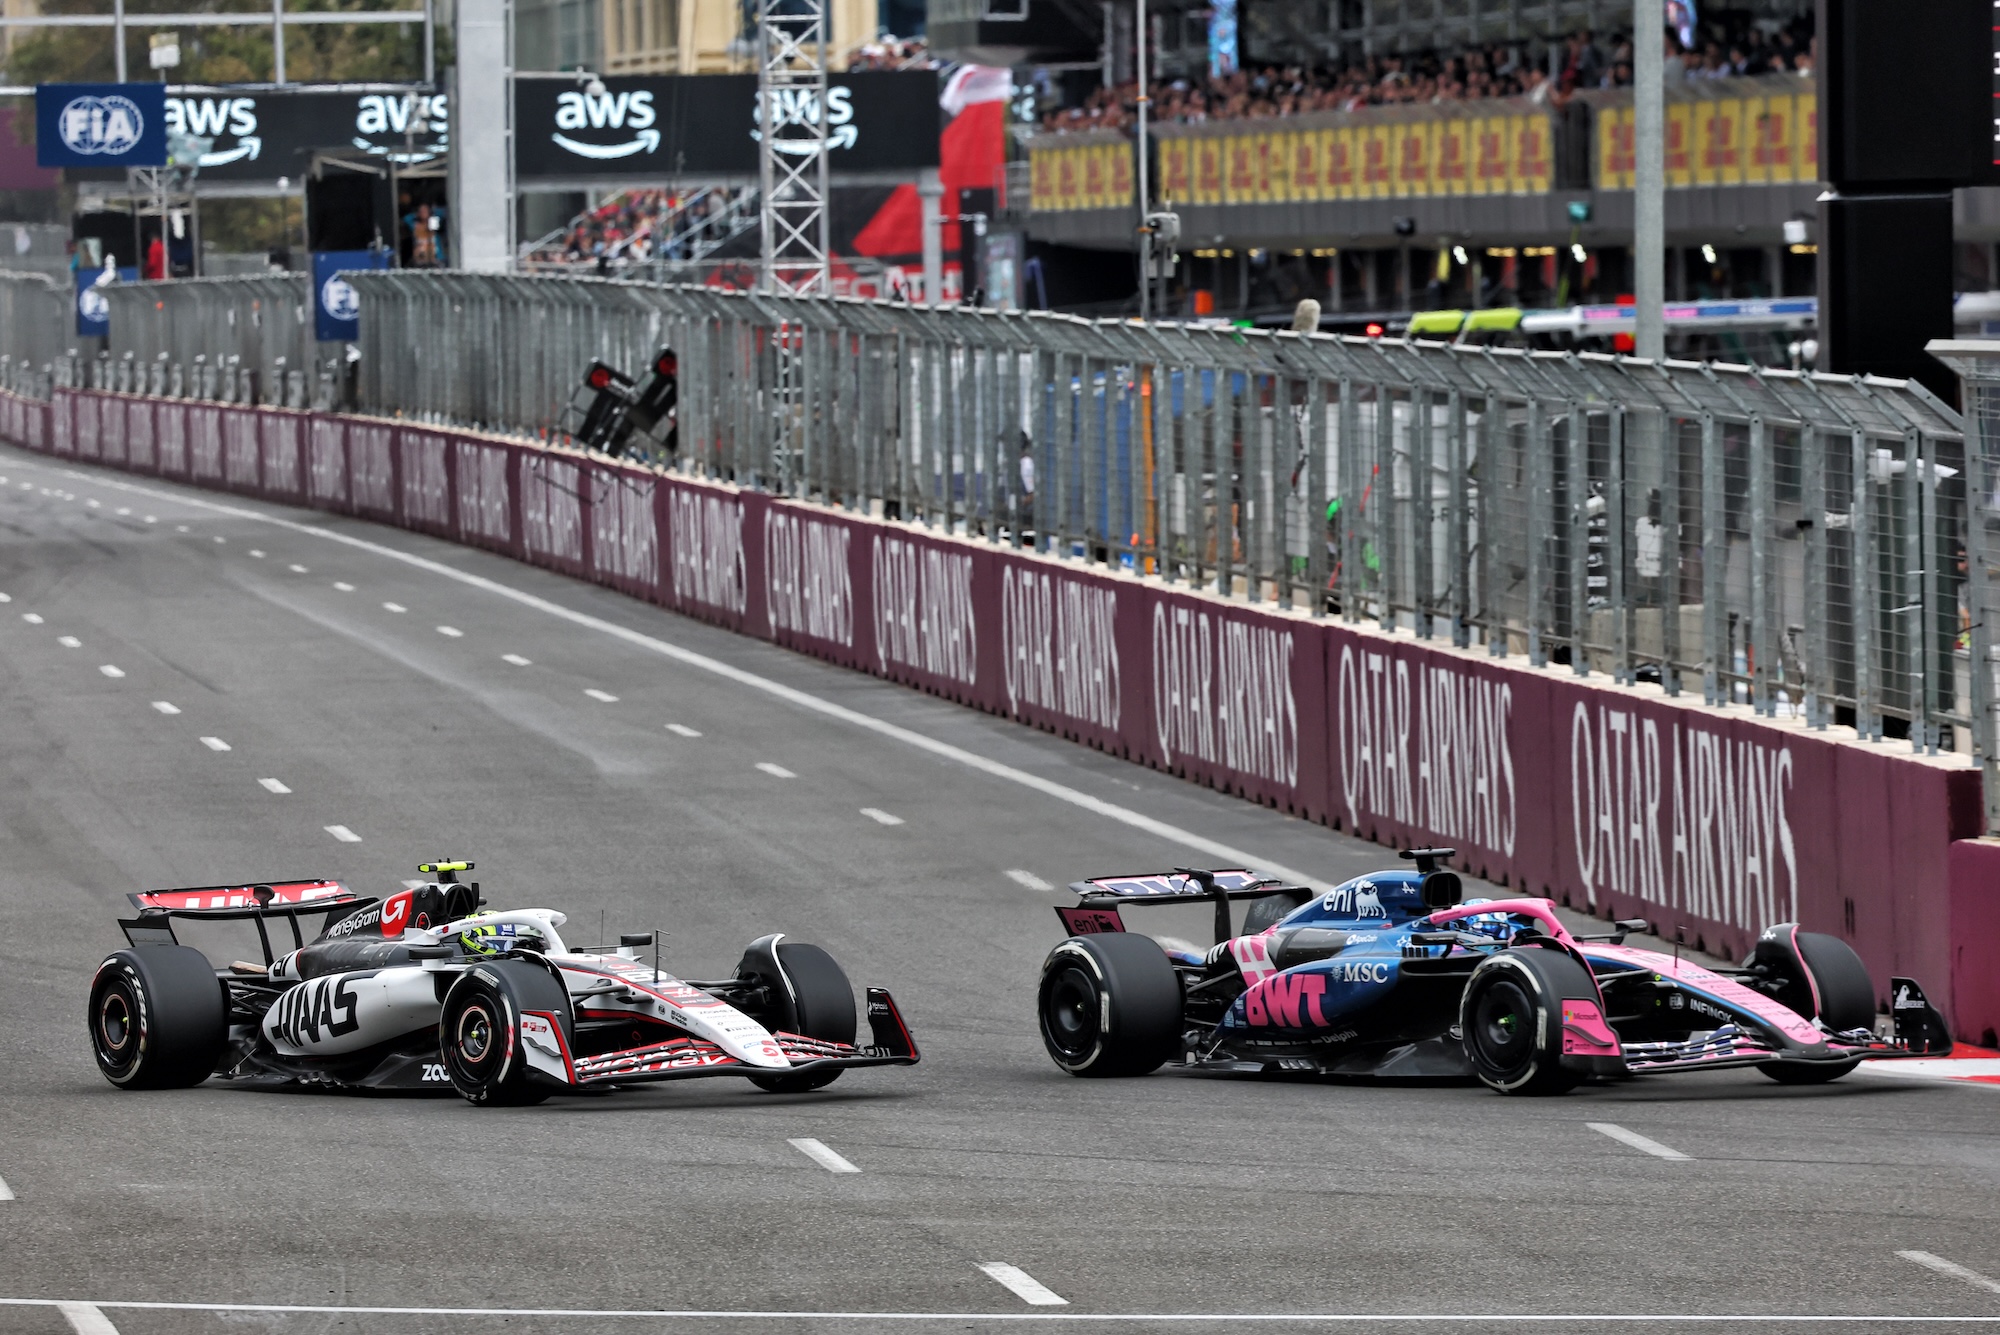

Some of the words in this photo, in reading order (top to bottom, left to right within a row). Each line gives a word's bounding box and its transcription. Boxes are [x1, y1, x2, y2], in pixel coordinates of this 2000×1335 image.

[555, 90, 656, 130] aws
[1002, 564, 1056, 714] QATAR
[1057, 577, 1120, 732] AIRWAYS
[1153, 601, 1216, 766] QATAR
[1218, 616, 1298, 788] AIRWAYS
[1339, 644, 1414, 826] QATAR
[1419, 662, 1516, 858] AIRWAYS
[1572, 701, 1667, 907] QATAR
[1672, 722, 1798, 933] AIRWAYS
[1323, 882, 1356, 912] eni
[326, 909, 380, 940] MoneyGram
[1074, 917, 1096, 934] eni
[1344, 962, 1388, 984] MSC
[271, 969, 384, 1048] HAAS
[1246, 973, 1331, 1028] BWT
[1690, 998, 1733, 1023] INFINOX
